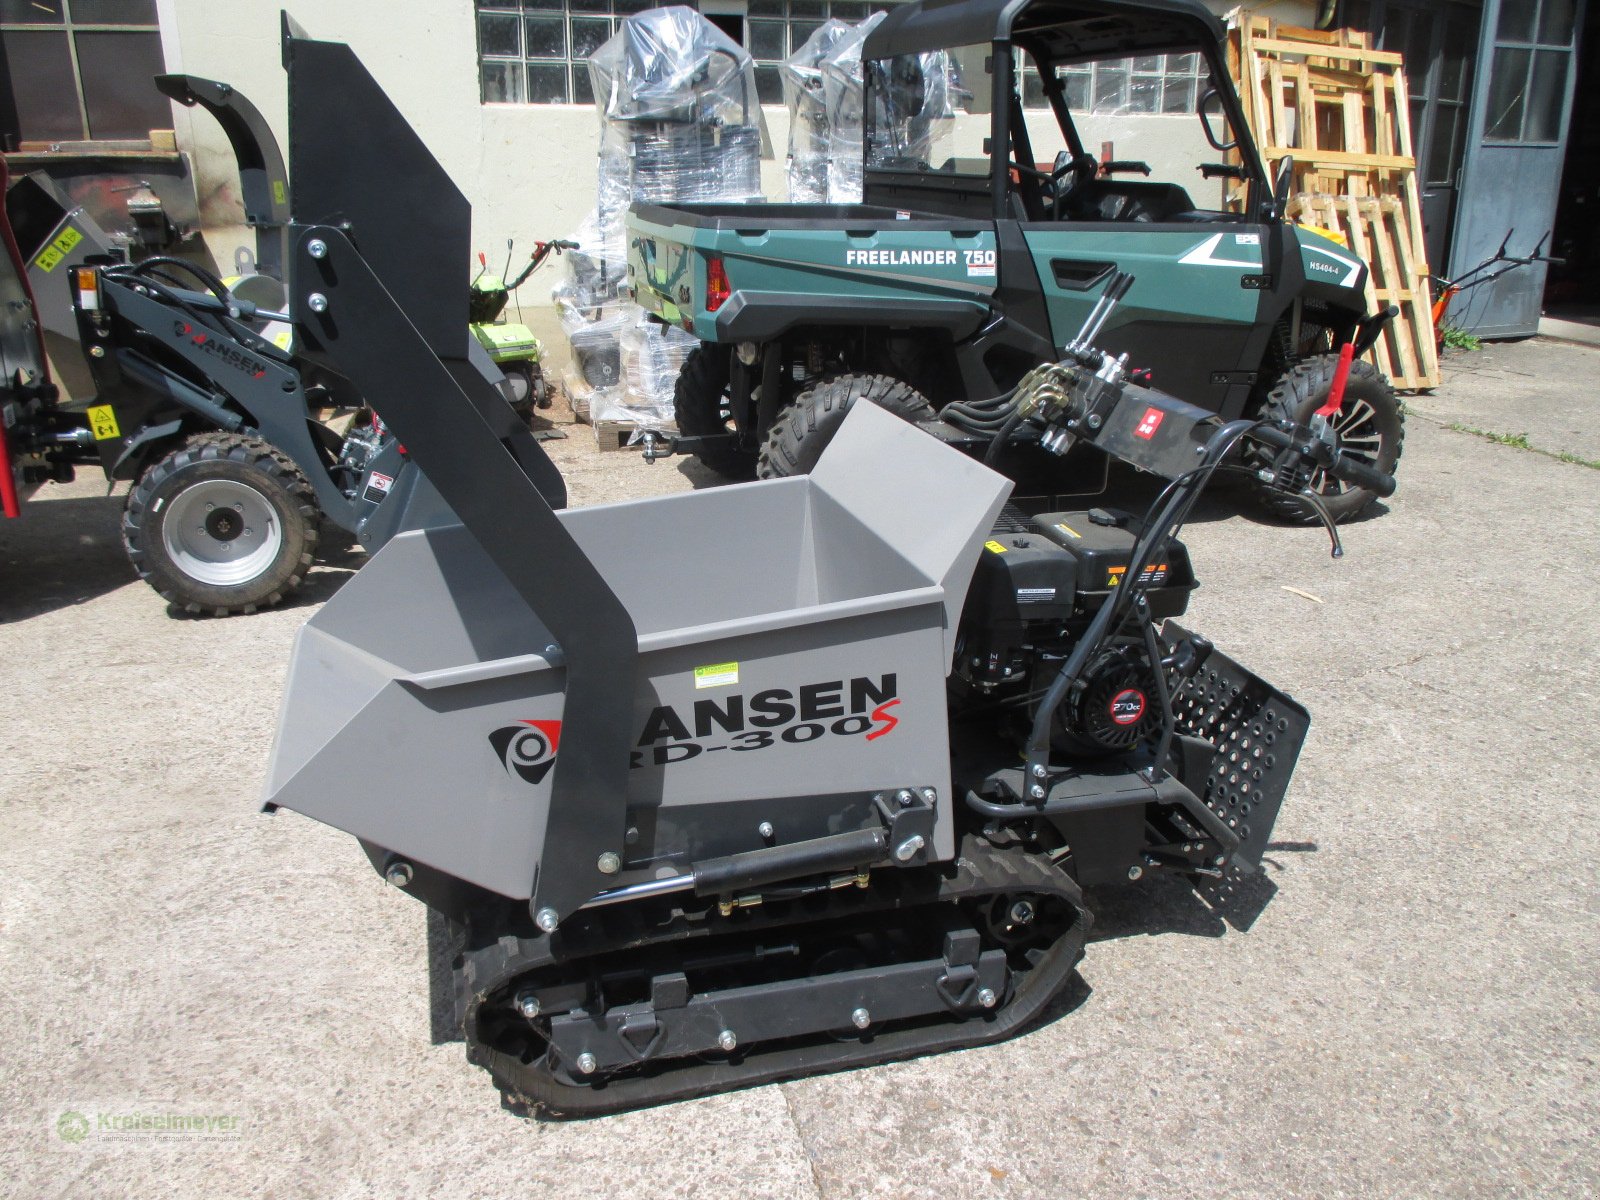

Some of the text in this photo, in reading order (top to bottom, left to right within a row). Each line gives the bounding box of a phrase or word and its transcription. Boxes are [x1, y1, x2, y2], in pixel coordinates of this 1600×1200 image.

[846, 250, 996, 265] FREELANDER 750
[1309, 261, 1339, 275] HS404-4
[636, 672, 897, 748] ANSEN
[1113, 702, 1141, 712] 270cc
